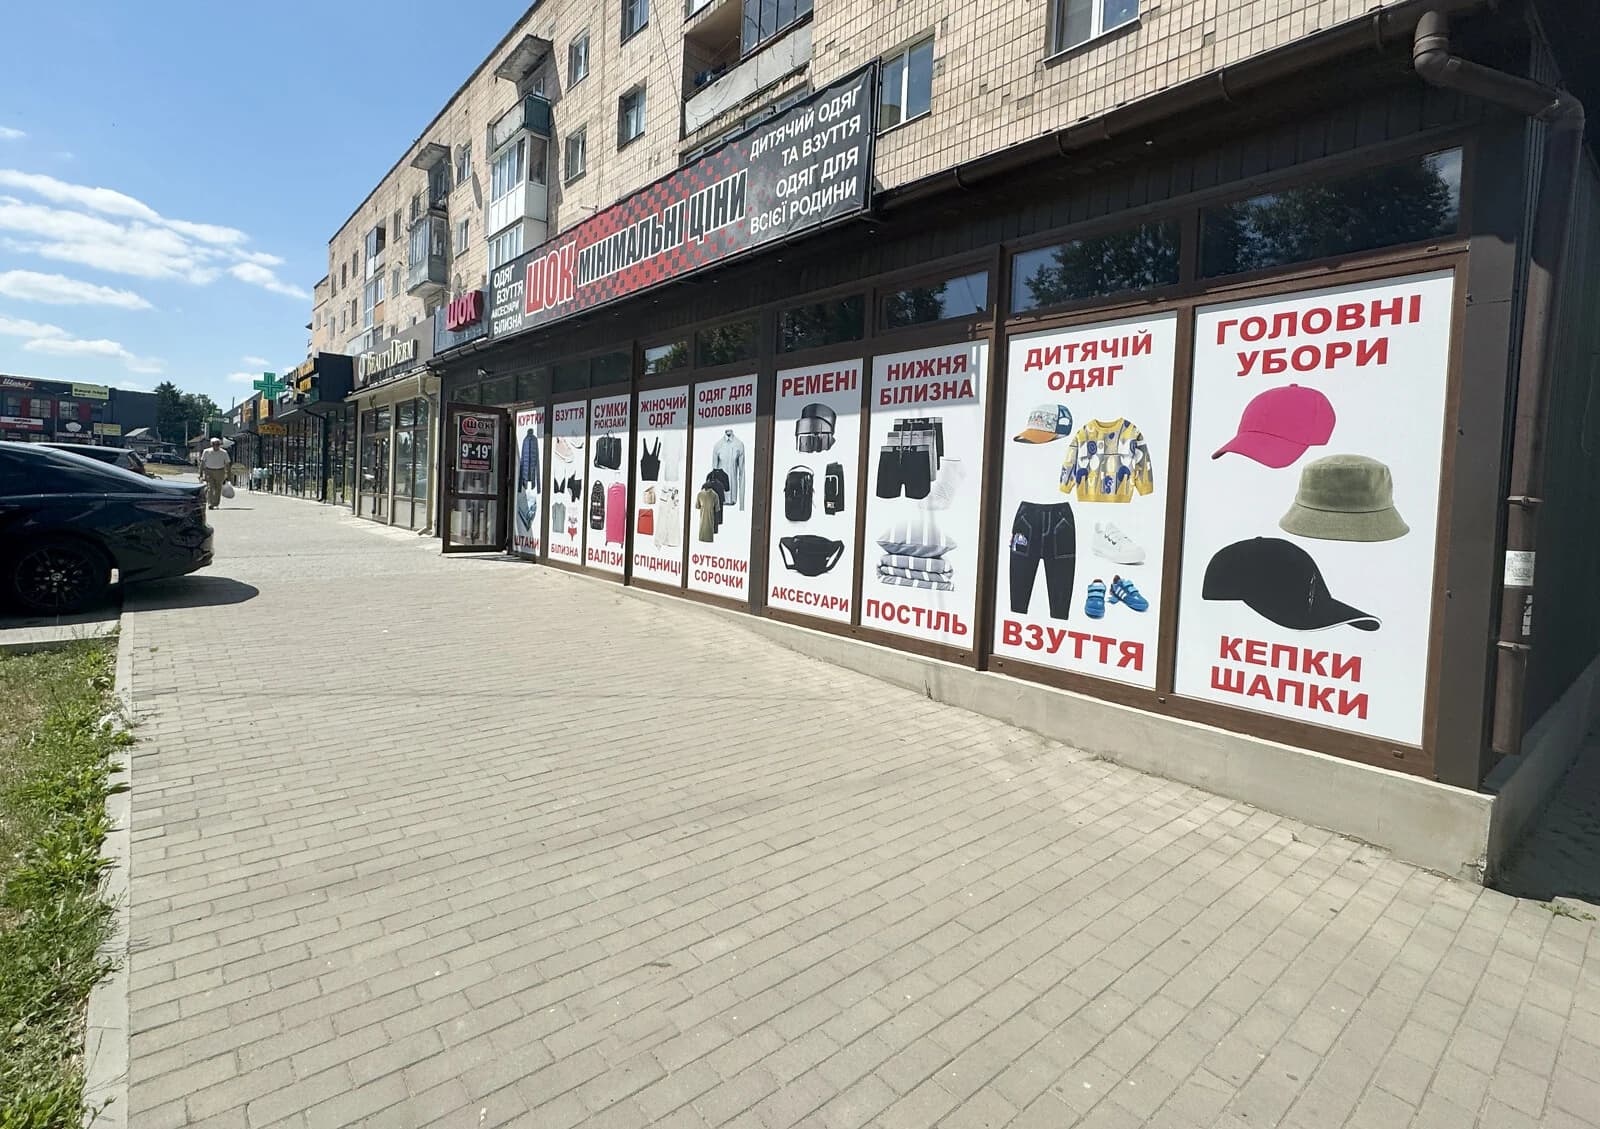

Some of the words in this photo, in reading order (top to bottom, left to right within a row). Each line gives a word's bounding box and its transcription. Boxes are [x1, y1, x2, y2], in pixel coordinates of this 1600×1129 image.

[750, 109, 814, 161] ДИТЯЧИЙ
[818, 85, 862, 122] ОДЯГ
[781, 146, 798, 167] ТА
[802, 115, 861, 158] ВЗУТТЯ
[776, 163, 819, 198] ОДЯГ
[820, 146, 859, 183] ДЛЯ
[750, 201, 788, 235] ВСІЄЇ
[790, 176, 857, 220] РОДИНИ
[525, 240, 576, 317] ШОК
[577, 199, 686, 288] МІНІМАЛЬНІ
[688, 168, 748, 245] ЦІНИ
[493, 264, 515, 289] ОДЯГ
[496, 280, 524, 305] ВЗУТТЯ
[447, 290, 479, 331] ШОК
[493, 313, 522, 335] БІЛИЗНА
[1216, 294, 1421, 345] ГОЛОВНІ
[1024, 328, 1153, 372] ДИТЯЧІЙ
[1236, 337, 1389, 377] УБОРИ
[886, 353, 968, 381] НИЖНЯ
[1047, 364, 1124, 393] ОДЯГ
[699, 387, 726, 403] ОДЯГ
[728, 383, 753, 399] ДЛЯ
[781, 369, 857, 397] РЕМЕНІ
[879, 378, 974, 406] БІЛИЗНА
[555, 407, 585, 423] ВЗУТТЯ
[594, 401, 628, 419] СУМКИ
[640, 393, 687, 413] ЖІНОЧИЙ
[698, 402, 753, 419] ЧОЛОВІКІВ
[517, 412, 545, 427] КУРТКИ
[594, 417, 627, 430] РЮКЗАКИ
[649, 411, 676, 428] ОДЯГ
[514, 535, 540, 549] ШТАНИ
[551, 543, 579, 558] БІЛИЗНА
[587, 547, 624, 567] ВАЛІЗИ
[634, 553, 682, 577] СПІДНИЦІ
[691, 552, 748, 574] ФУТБОЛКИ
[694, 568, 744, 590] СОРОЧКИ
[771, 585, 849, 613] АКСЕСУАРИ
[866, 598, 968, 636] ПОСТІЛЬ
[1002, 619, 1146, 673] ВЗУТТЯ
[1219, 635, 1363, 684] КЕПКИ
[1210, 665, 1370, 721] ШАПКИ
